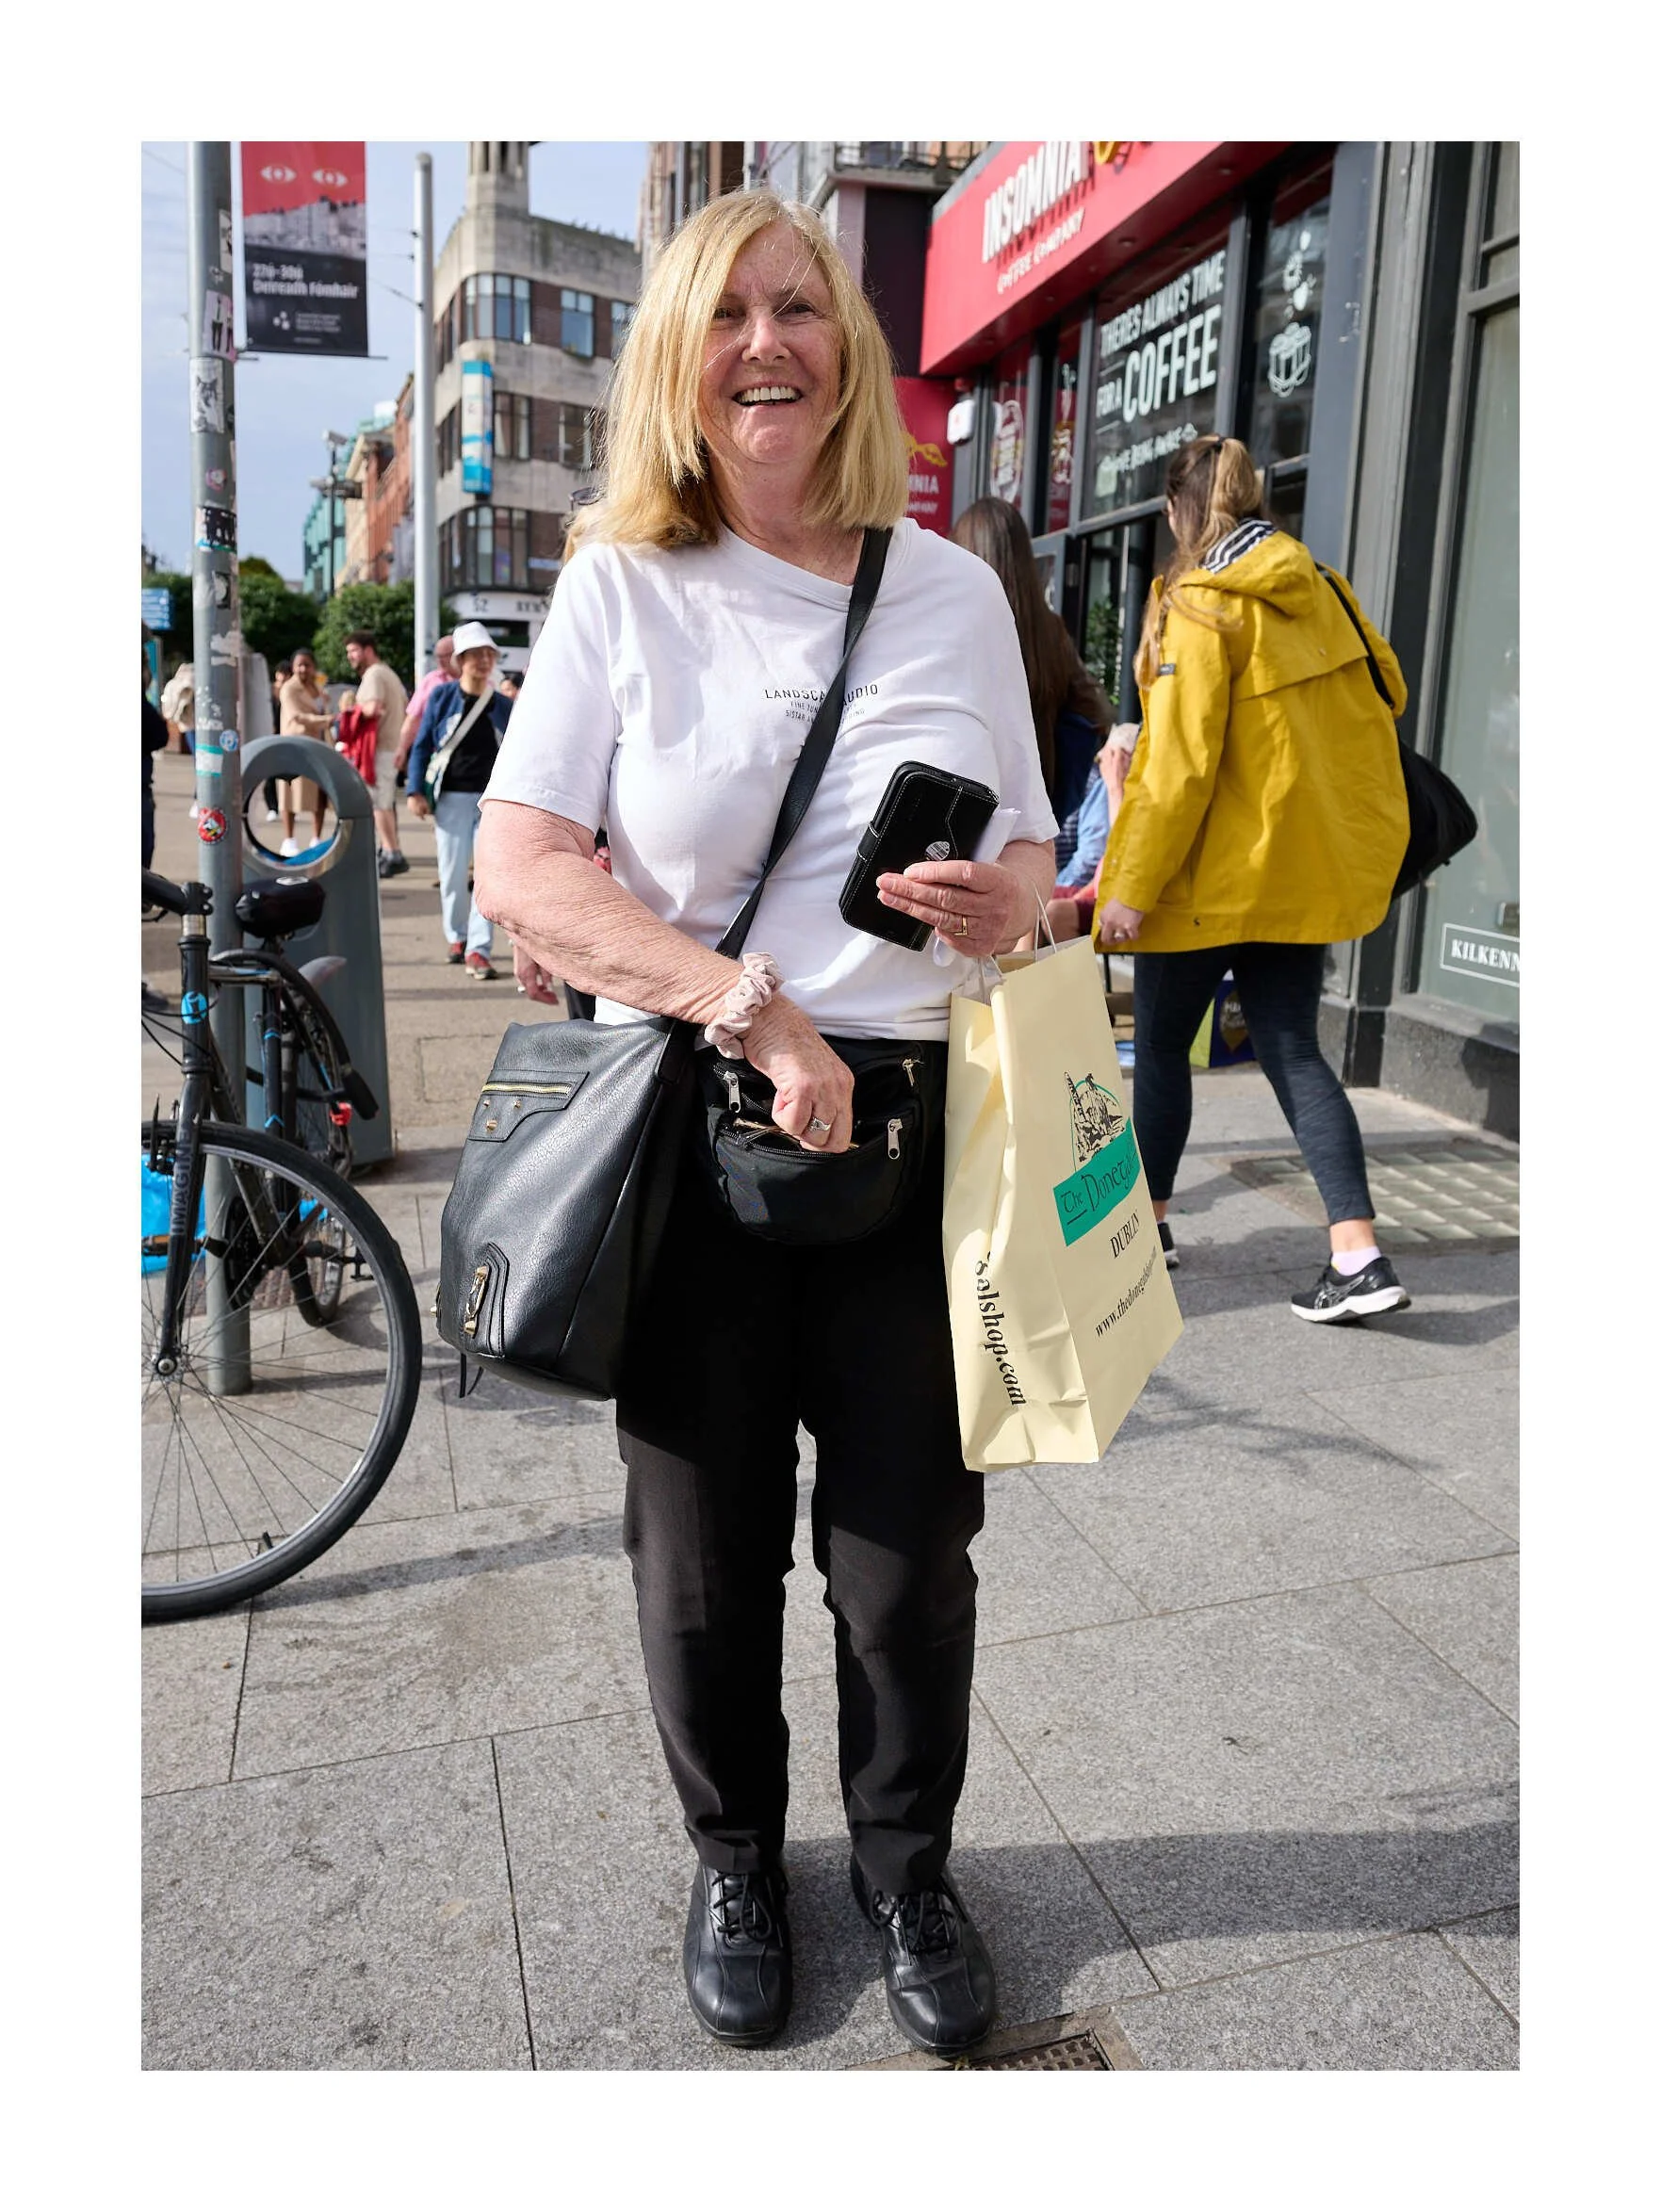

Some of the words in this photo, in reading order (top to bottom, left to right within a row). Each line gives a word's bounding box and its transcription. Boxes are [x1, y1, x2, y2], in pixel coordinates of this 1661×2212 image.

[983, 141, 1087, 264] INSOMNIA
[1141, 273, 1191, 335] ALWAYS
[1191, 250, 1226, 306] TIME
[1096, 381, 1115, 419] FOR
[1114, 377, 1123, 410] A
[1122, 303, 1222, 423] COFFEE
[764, 688, 827, 703] LANDSCA
[1452, 938, 1520, 972] KILKENN
[1061, 1190, 1084, 1213] The
[1110, 1210, 1140, 1260] DUBLIN
